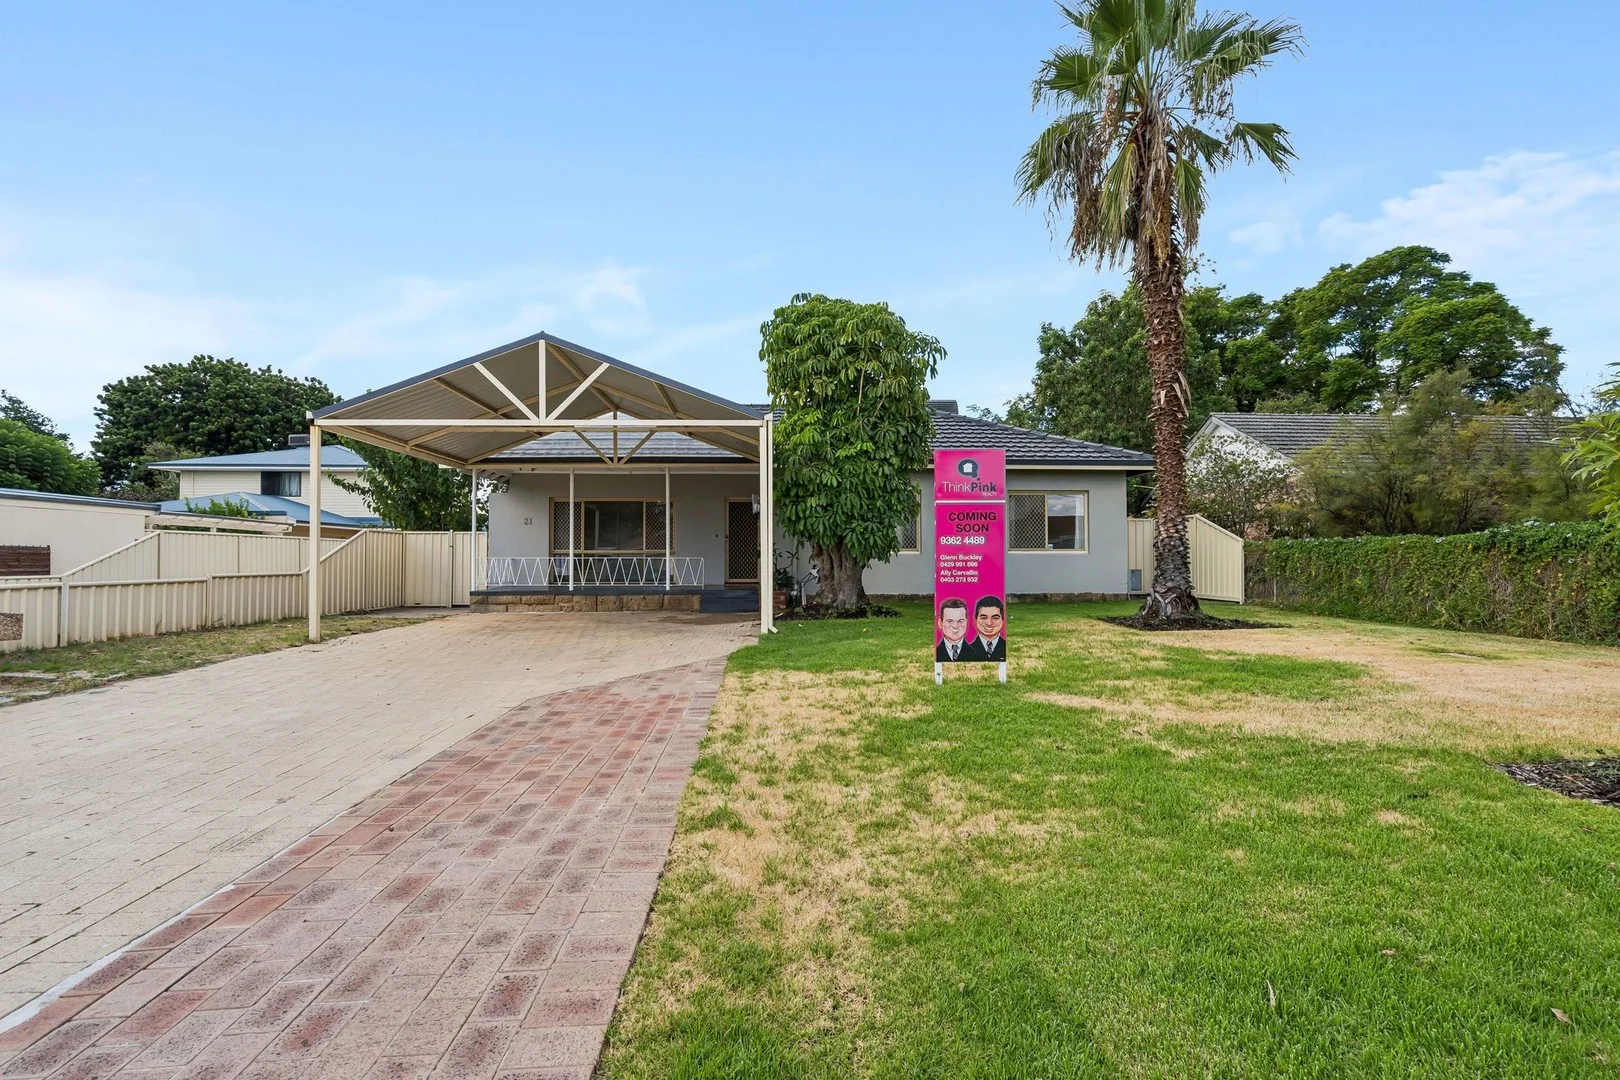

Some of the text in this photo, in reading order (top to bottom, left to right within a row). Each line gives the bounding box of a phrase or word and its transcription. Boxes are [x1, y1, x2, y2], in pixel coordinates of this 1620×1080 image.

[941, 481, 997, 492] ThinkPink
[948, 511, 997, 521] COMING
[523, 517, 533, 525] 21
[955, 523, 989, 533] SOON
[940, 536, 985, 545] 9362 4489
[958, 554, 983, 562] Buckley
